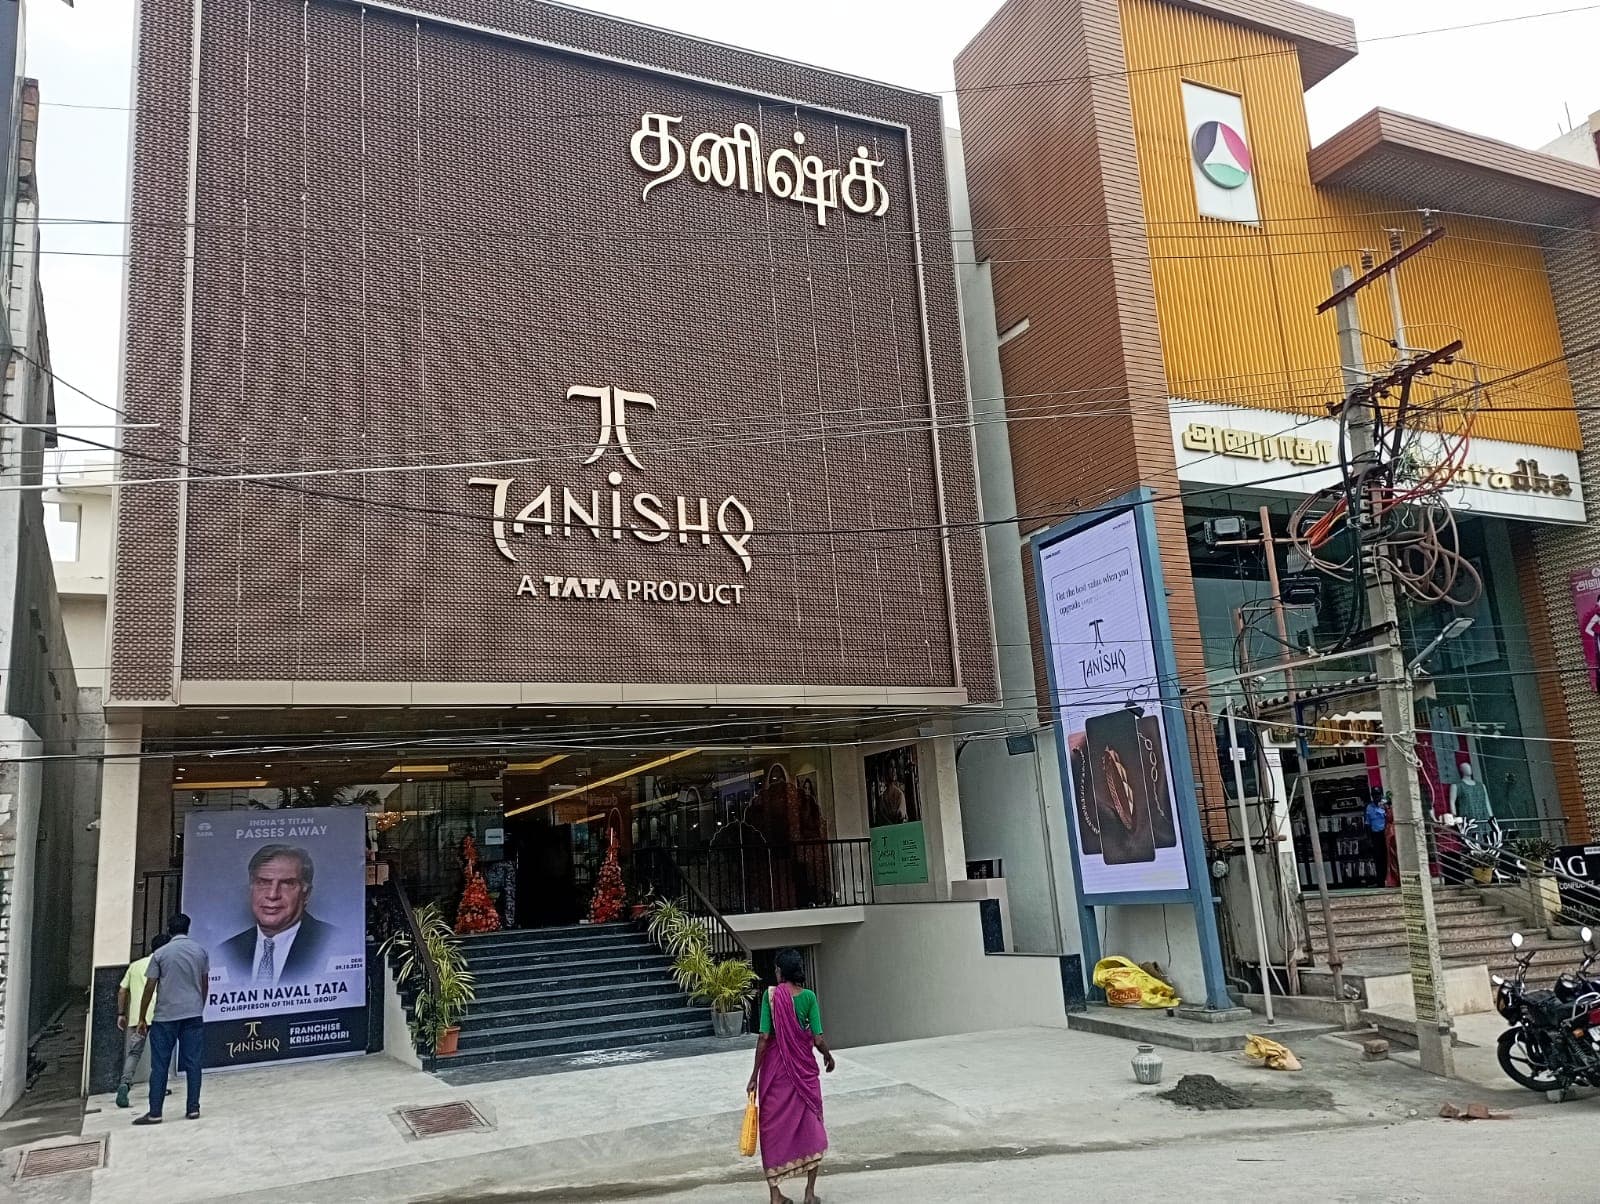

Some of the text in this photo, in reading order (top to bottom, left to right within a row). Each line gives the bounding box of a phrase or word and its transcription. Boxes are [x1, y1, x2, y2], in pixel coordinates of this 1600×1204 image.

[630, 112, 890, 226] தனிஷ்க்
[1117, 568, 1129, 582] you
[516, 575, 745, 605] A TATA PRODUCT
[249, 817, 315, 828] INDIA'S TITAN
[235, 825, 328, 840] PASSES AWAY
[209, 981, 348, 1006] RATAN NAVAL TATA
[220, 995, 338, 1013] CHAIRPERSON OF THE TATA GROUP
[289, 1022, 342, 1036] FRANCHISE
[289, 1030, 350, 1045] KRISHNAGIRI
